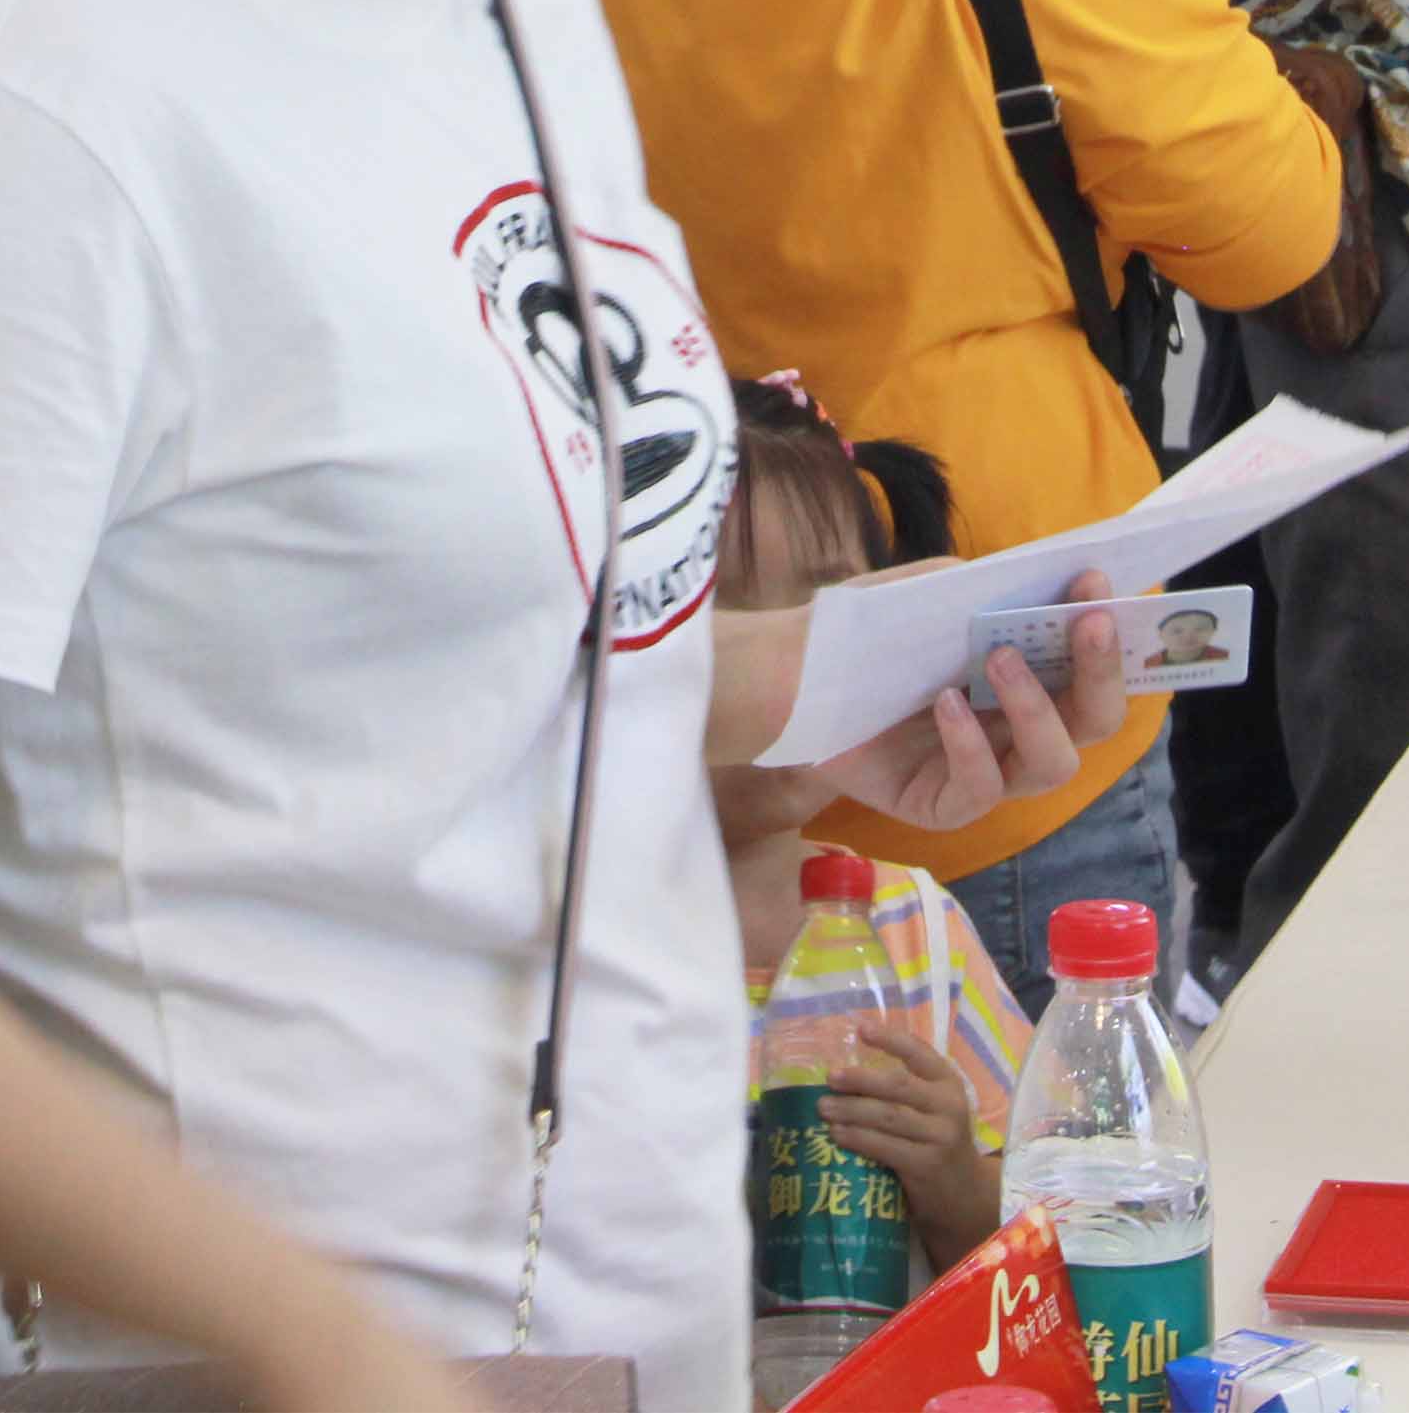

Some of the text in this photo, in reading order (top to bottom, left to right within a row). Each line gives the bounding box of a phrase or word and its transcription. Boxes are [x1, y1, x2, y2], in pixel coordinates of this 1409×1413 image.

[770, 1122, 877, 1169] 安家
[770, 1171, 905, 1221] 御龙花
